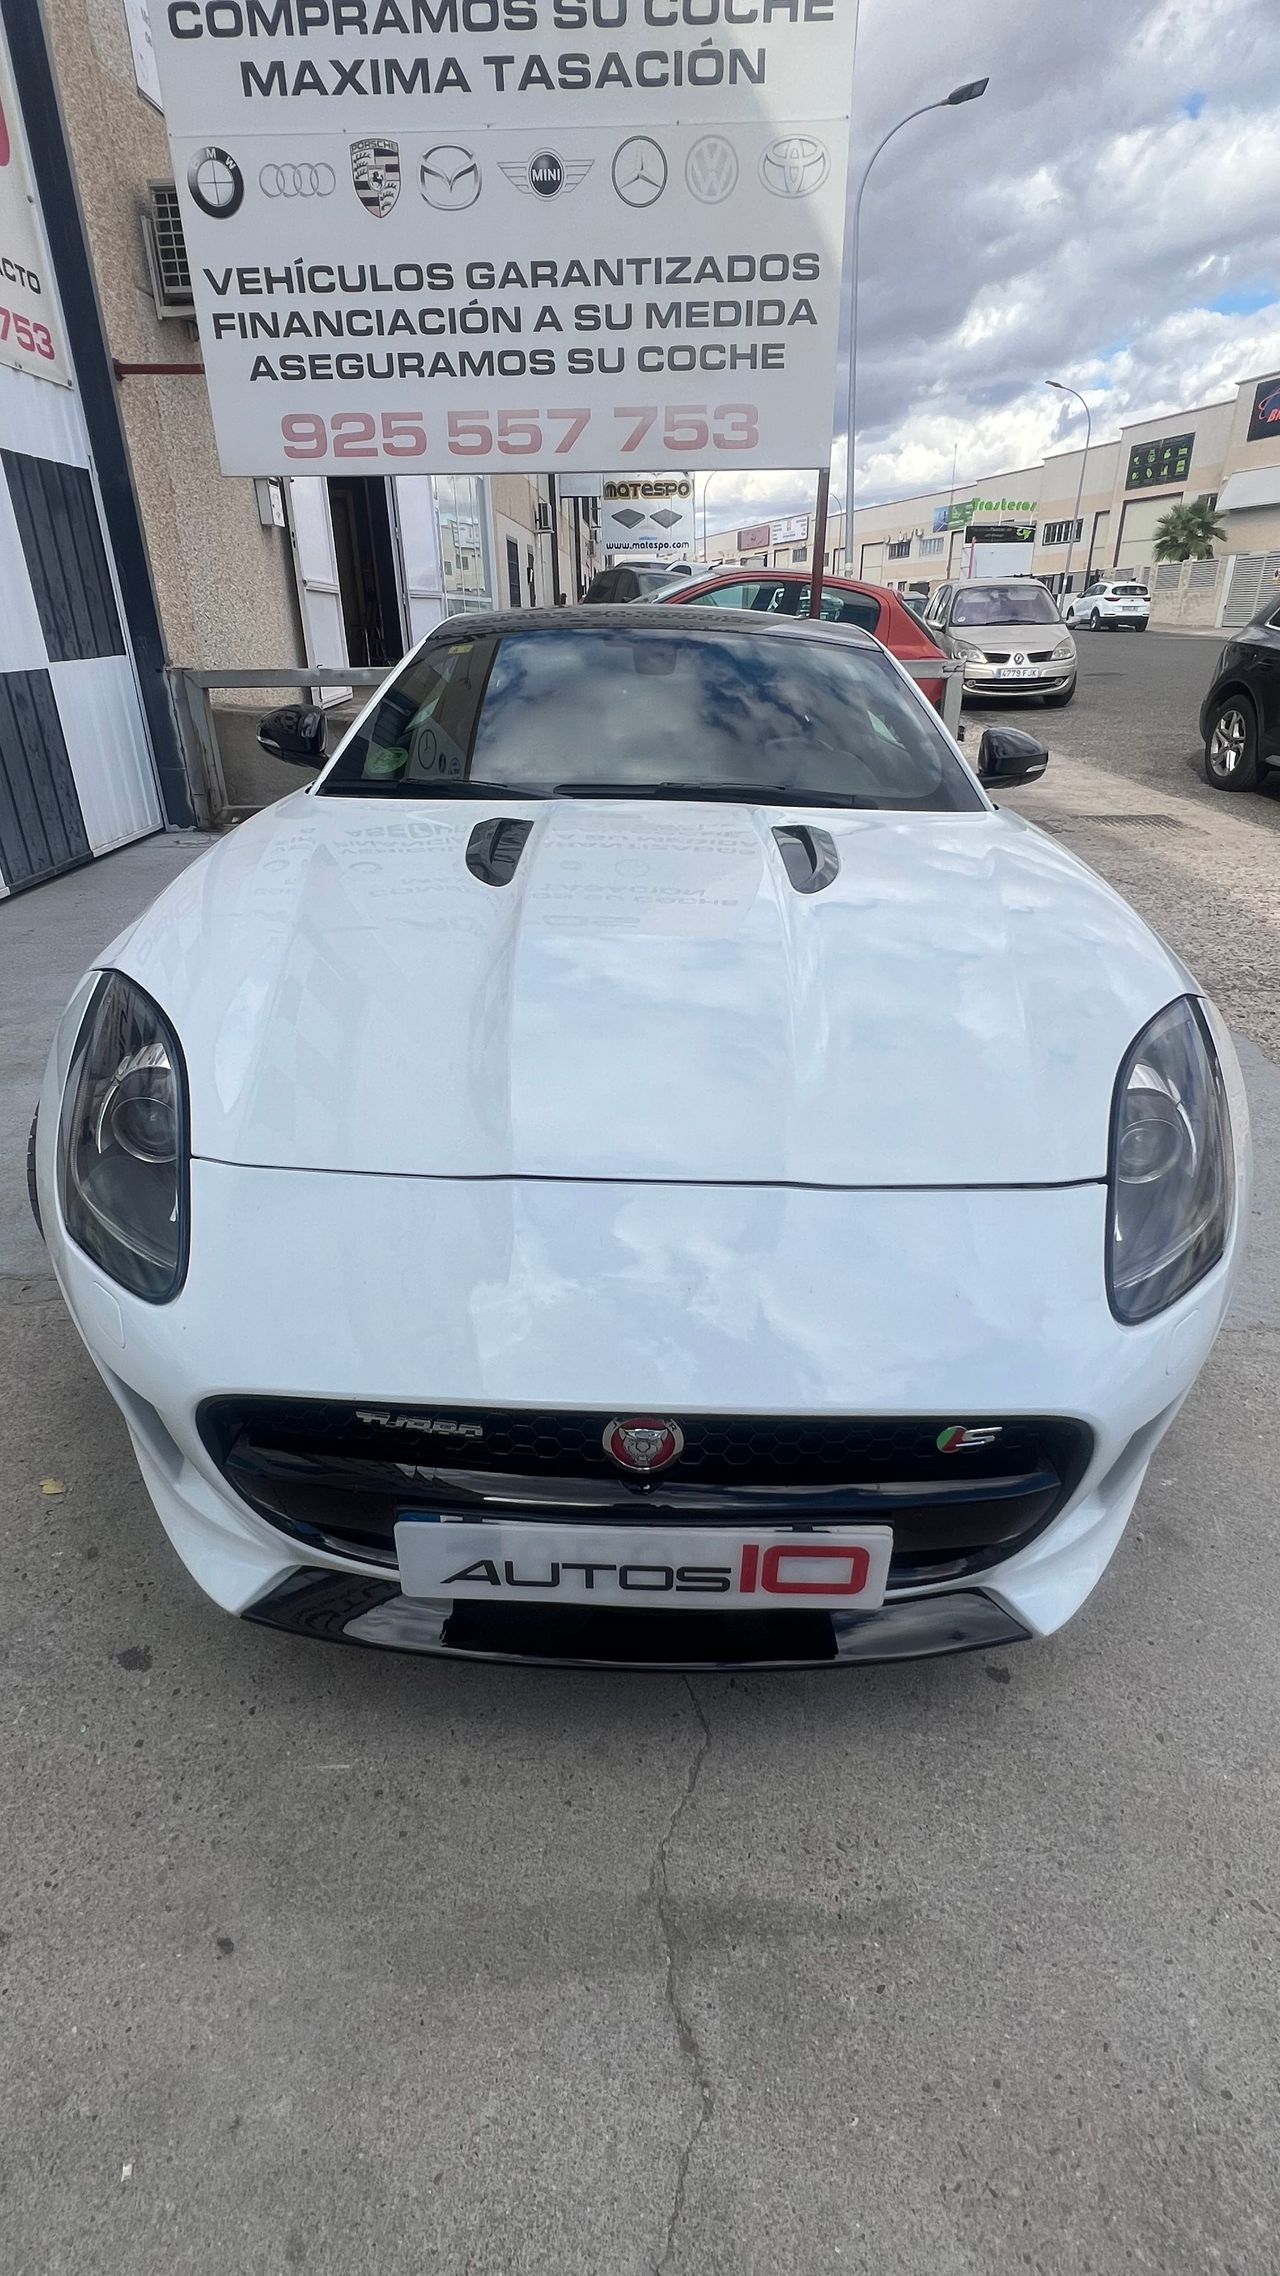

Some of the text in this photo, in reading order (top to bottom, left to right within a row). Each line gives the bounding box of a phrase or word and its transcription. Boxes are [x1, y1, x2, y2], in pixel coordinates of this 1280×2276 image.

[167, 0, 538, 39] COMPRAMOS
[554, 0, 627, 31] SU
[644, 0, 835, 27] COCHE
[240, 37, 767, 97] MAXIMA TASACIÓN
[531, 168, 561, 182] MINI
[0, 256, 42, 295] CTO
[202, 253, 820, 296] VEHÍCULOS GARANTIZADOS
[211, 298, 818, 339] FINANCIACIÓN A SU MEDIDA
[249, 343, 786, 381] ASEGURAMOS SU COCHE
[280, 403, 760, 459] 925 557 753
[972, 497, 1038, 512] Trasteros
[606, 541, 690, 551] www.matespo.com
